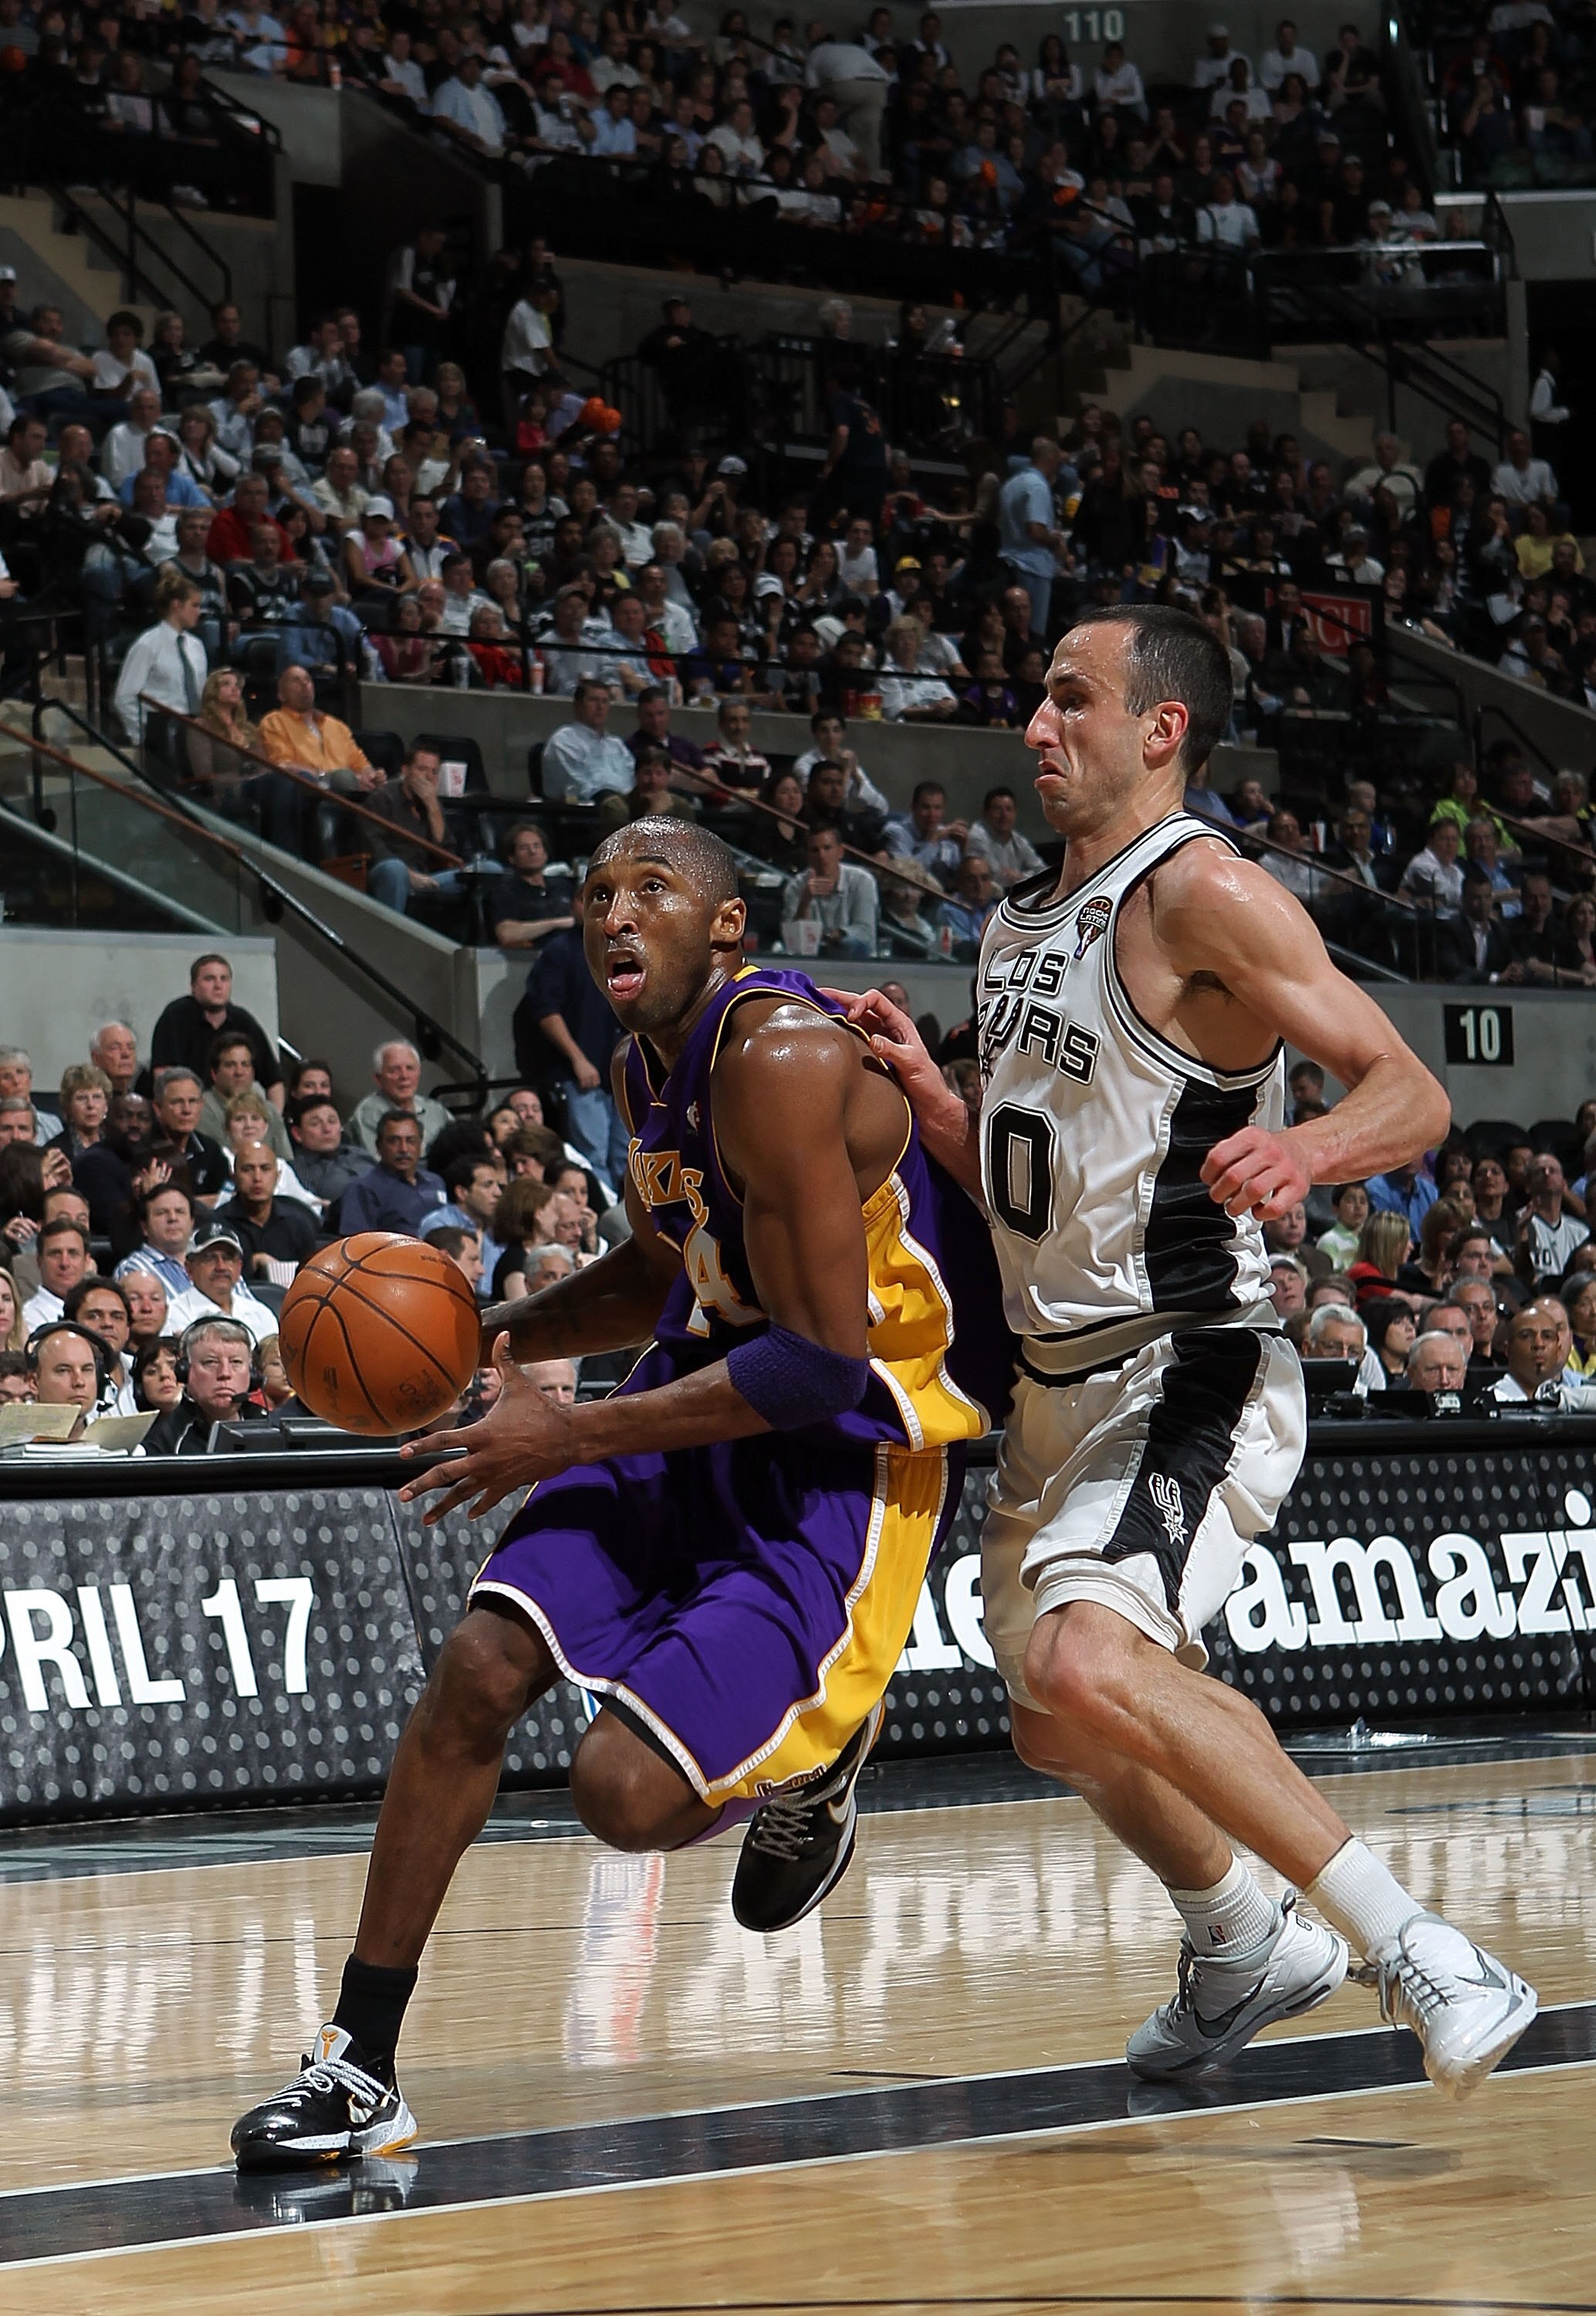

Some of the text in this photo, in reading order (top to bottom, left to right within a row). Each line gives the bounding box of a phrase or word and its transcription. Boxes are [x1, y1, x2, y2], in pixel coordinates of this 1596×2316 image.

[1064, 10, 1124, 42] 110
[984, 948, 1070, 998] LOS
[1459, 1008, 1500, 1062] 10
[984, 1099, 1058, 1247] 0
[1224, 1488, 1596, 1653] amazi
[0, 1576, 314, 1712] RIL 17
